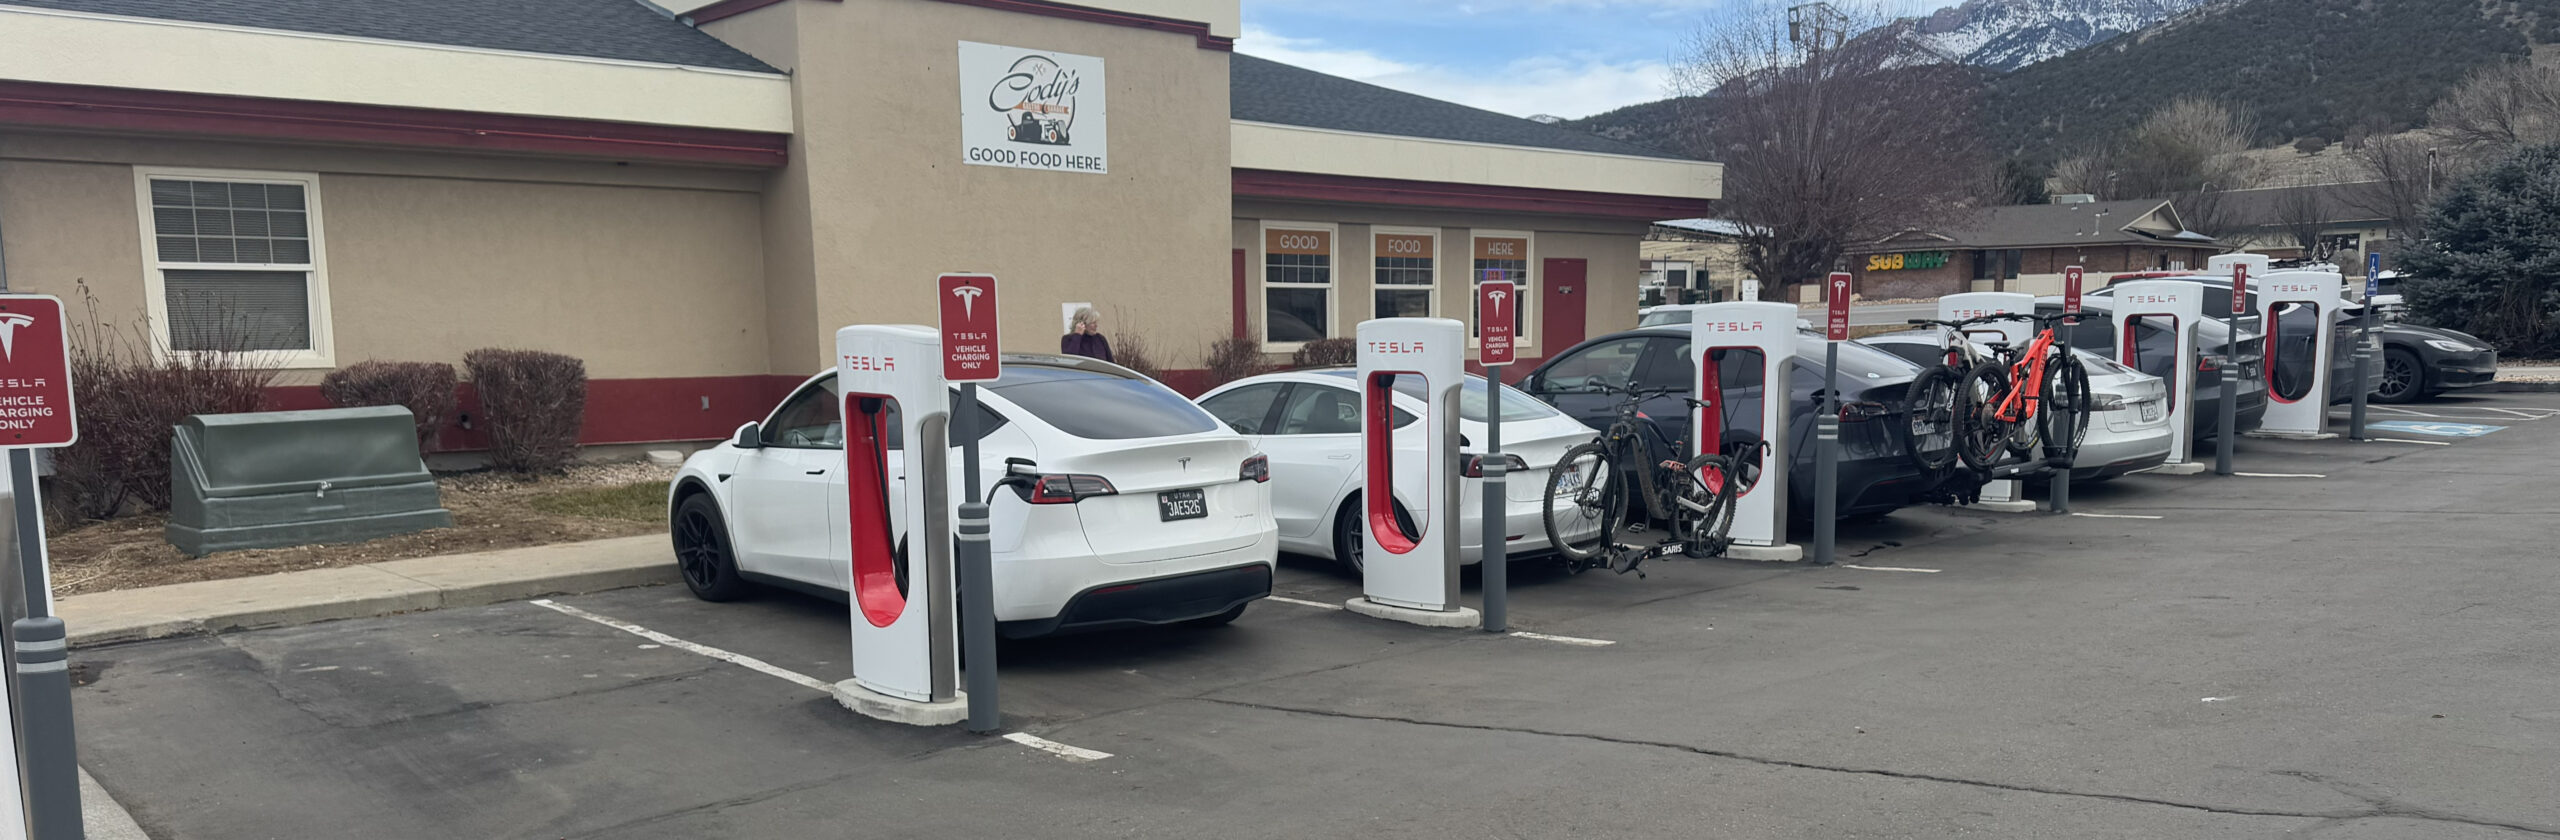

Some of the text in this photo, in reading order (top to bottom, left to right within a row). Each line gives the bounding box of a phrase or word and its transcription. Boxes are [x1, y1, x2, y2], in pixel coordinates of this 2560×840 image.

[989, 68, 1079, 113] Cody's
[970, 147, 1016, 164] GOOD
[1020, 151, 1062, 168] FOOD
[1280, 234, 1319, 250] GOOD
[1388, 239, 1421, 253] FOOD
[1488, 242, 1514, 256] HERE
[1866, 251, 1951, 272] SUBWAY
[2272, 284, 2318, 292] TESLA
[2128, 295, 2177, 303] TESLA
[1706, 321, 1763, 332] TESLA
[953, 332, 988, 340] TESLA
[955, 345, 986, 353] VEHICLE
[1368, 342, 1424, 353] TESLA
[951, 353, 991, 361] CHARGING
[844, 355, 895, 372] TESLA
[0, 396, 44, 406] HICLE
[0, 407, 53, 418] ARGING
[0, 419, 35, 430] ONLY
[1167, 499, 1201, 517] 3AE526
[1661, 544, 1683, 555] SARIS
